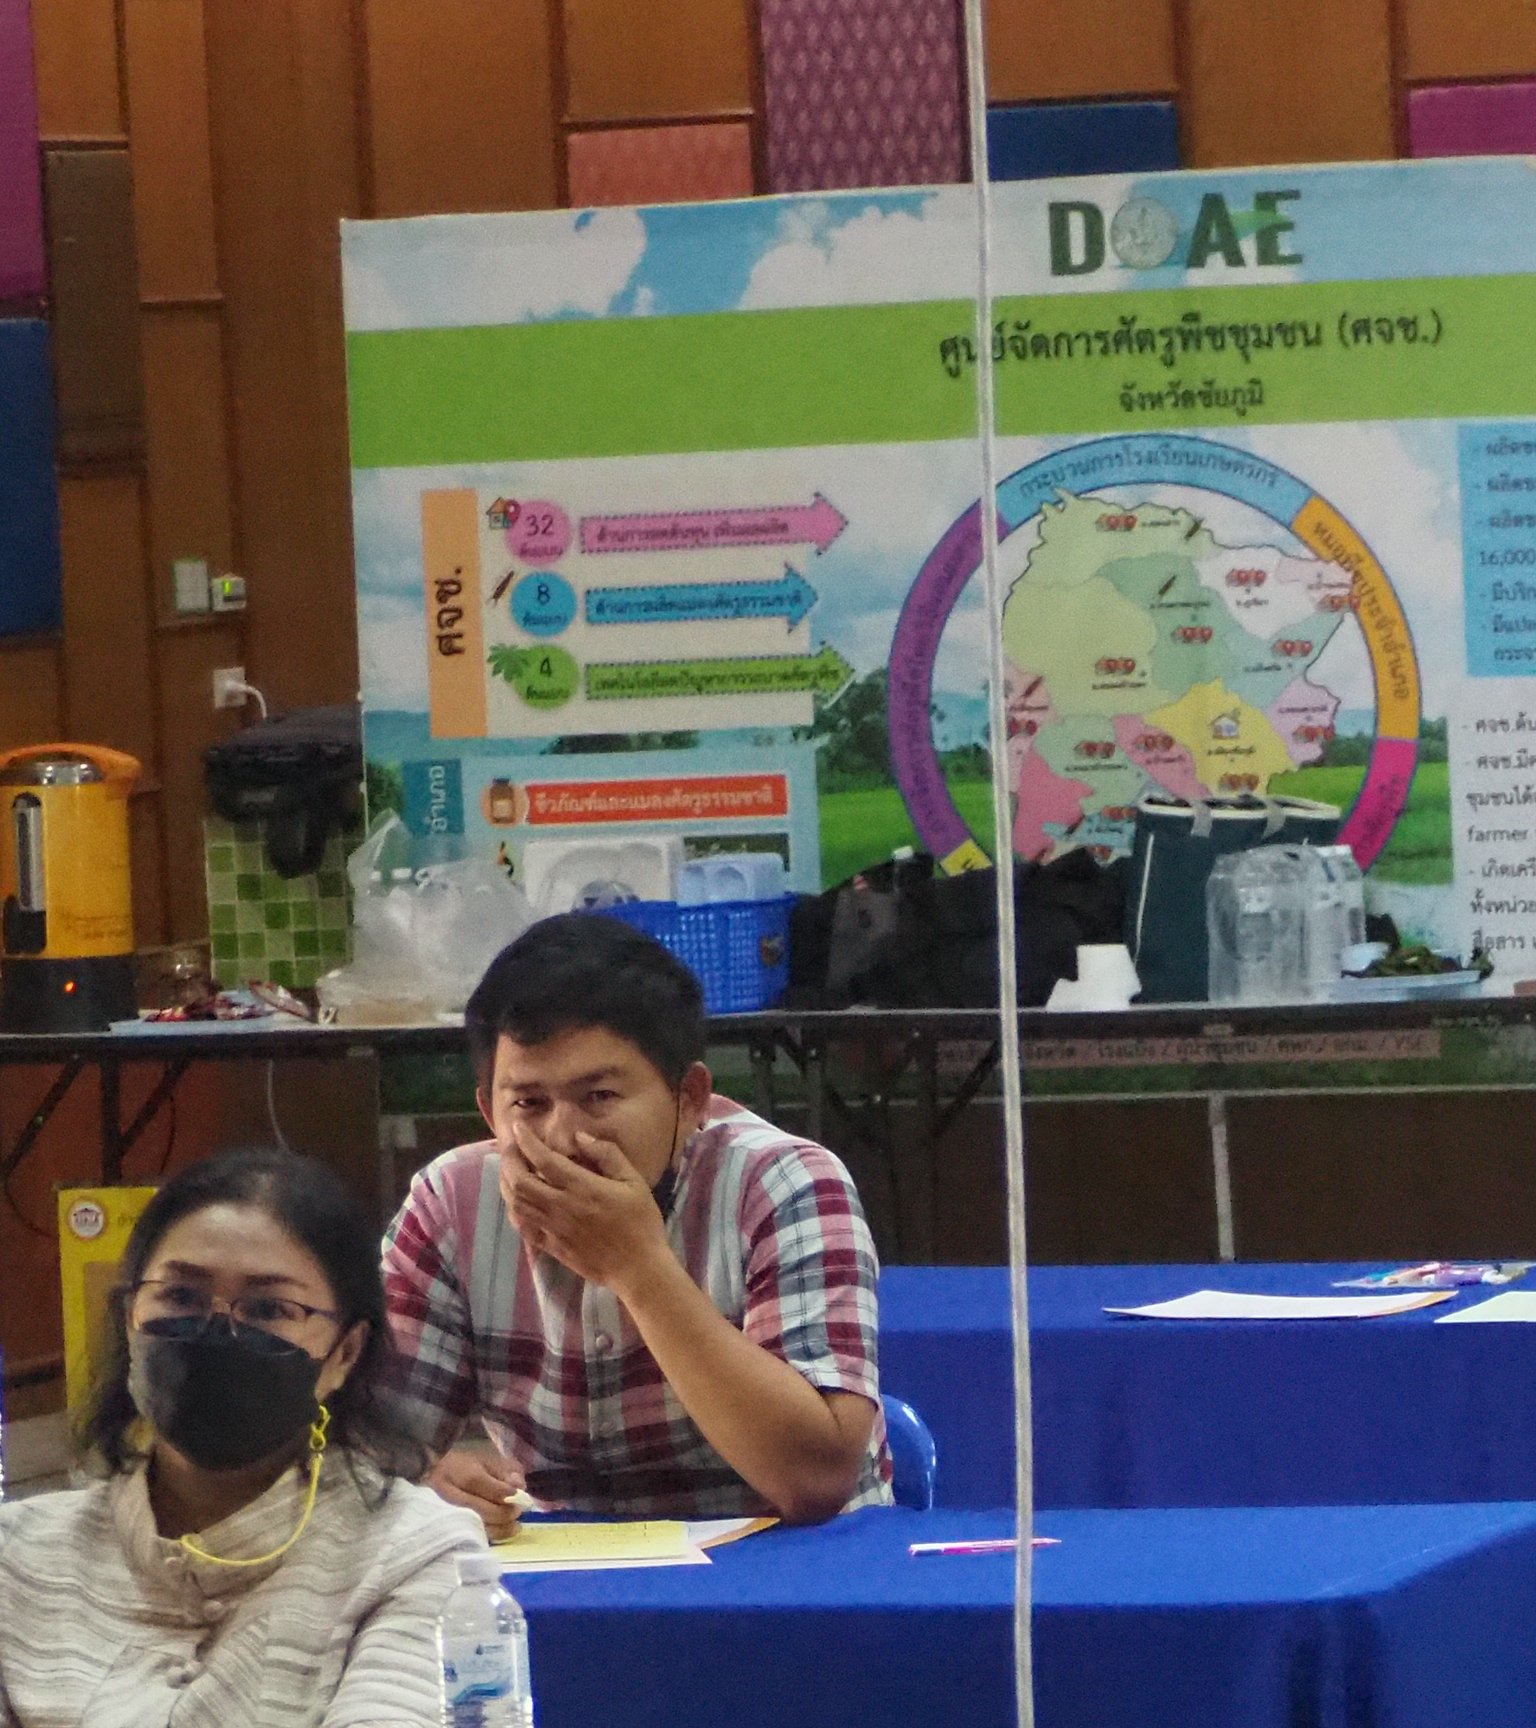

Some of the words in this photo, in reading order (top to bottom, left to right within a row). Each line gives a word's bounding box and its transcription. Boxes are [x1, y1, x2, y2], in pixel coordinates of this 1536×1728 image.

[1120, 378, 1265, 421] จังหวัดชัยภูมิ
[525, 512, 554, 538] 32
[536, 582, 552, 605] 8
[434, 565, 466, 658] ศจช.
[539, 657, 553, 677] 4
[1467, 823, 1530, 844] farmer
